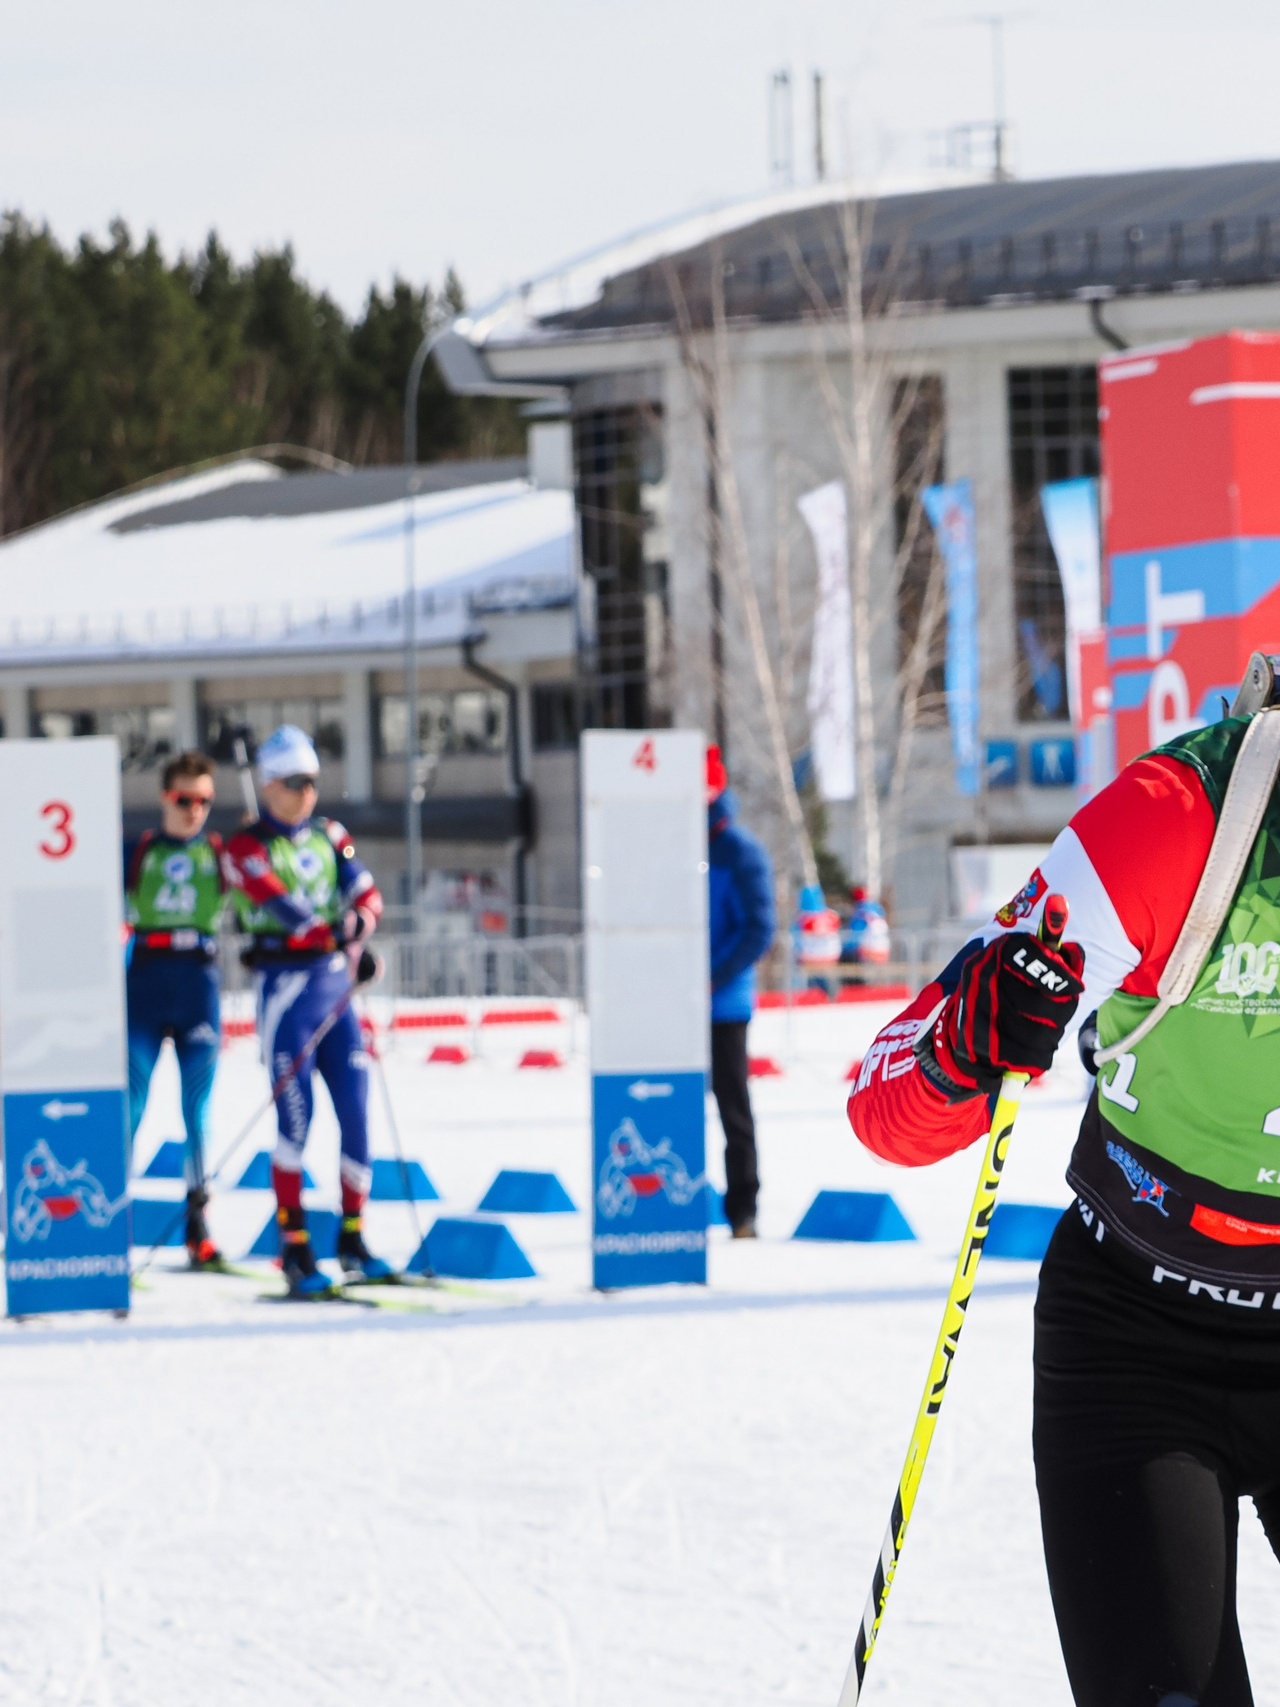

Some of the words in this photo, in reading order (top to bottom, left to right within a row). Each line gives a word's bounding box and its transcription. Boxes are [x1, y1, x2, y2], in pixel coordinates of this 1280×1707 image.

[632, 737, 657, 773] 4
[39, 799, 76, 861] 3
[1012, 948, 1069, 993] LEKI
